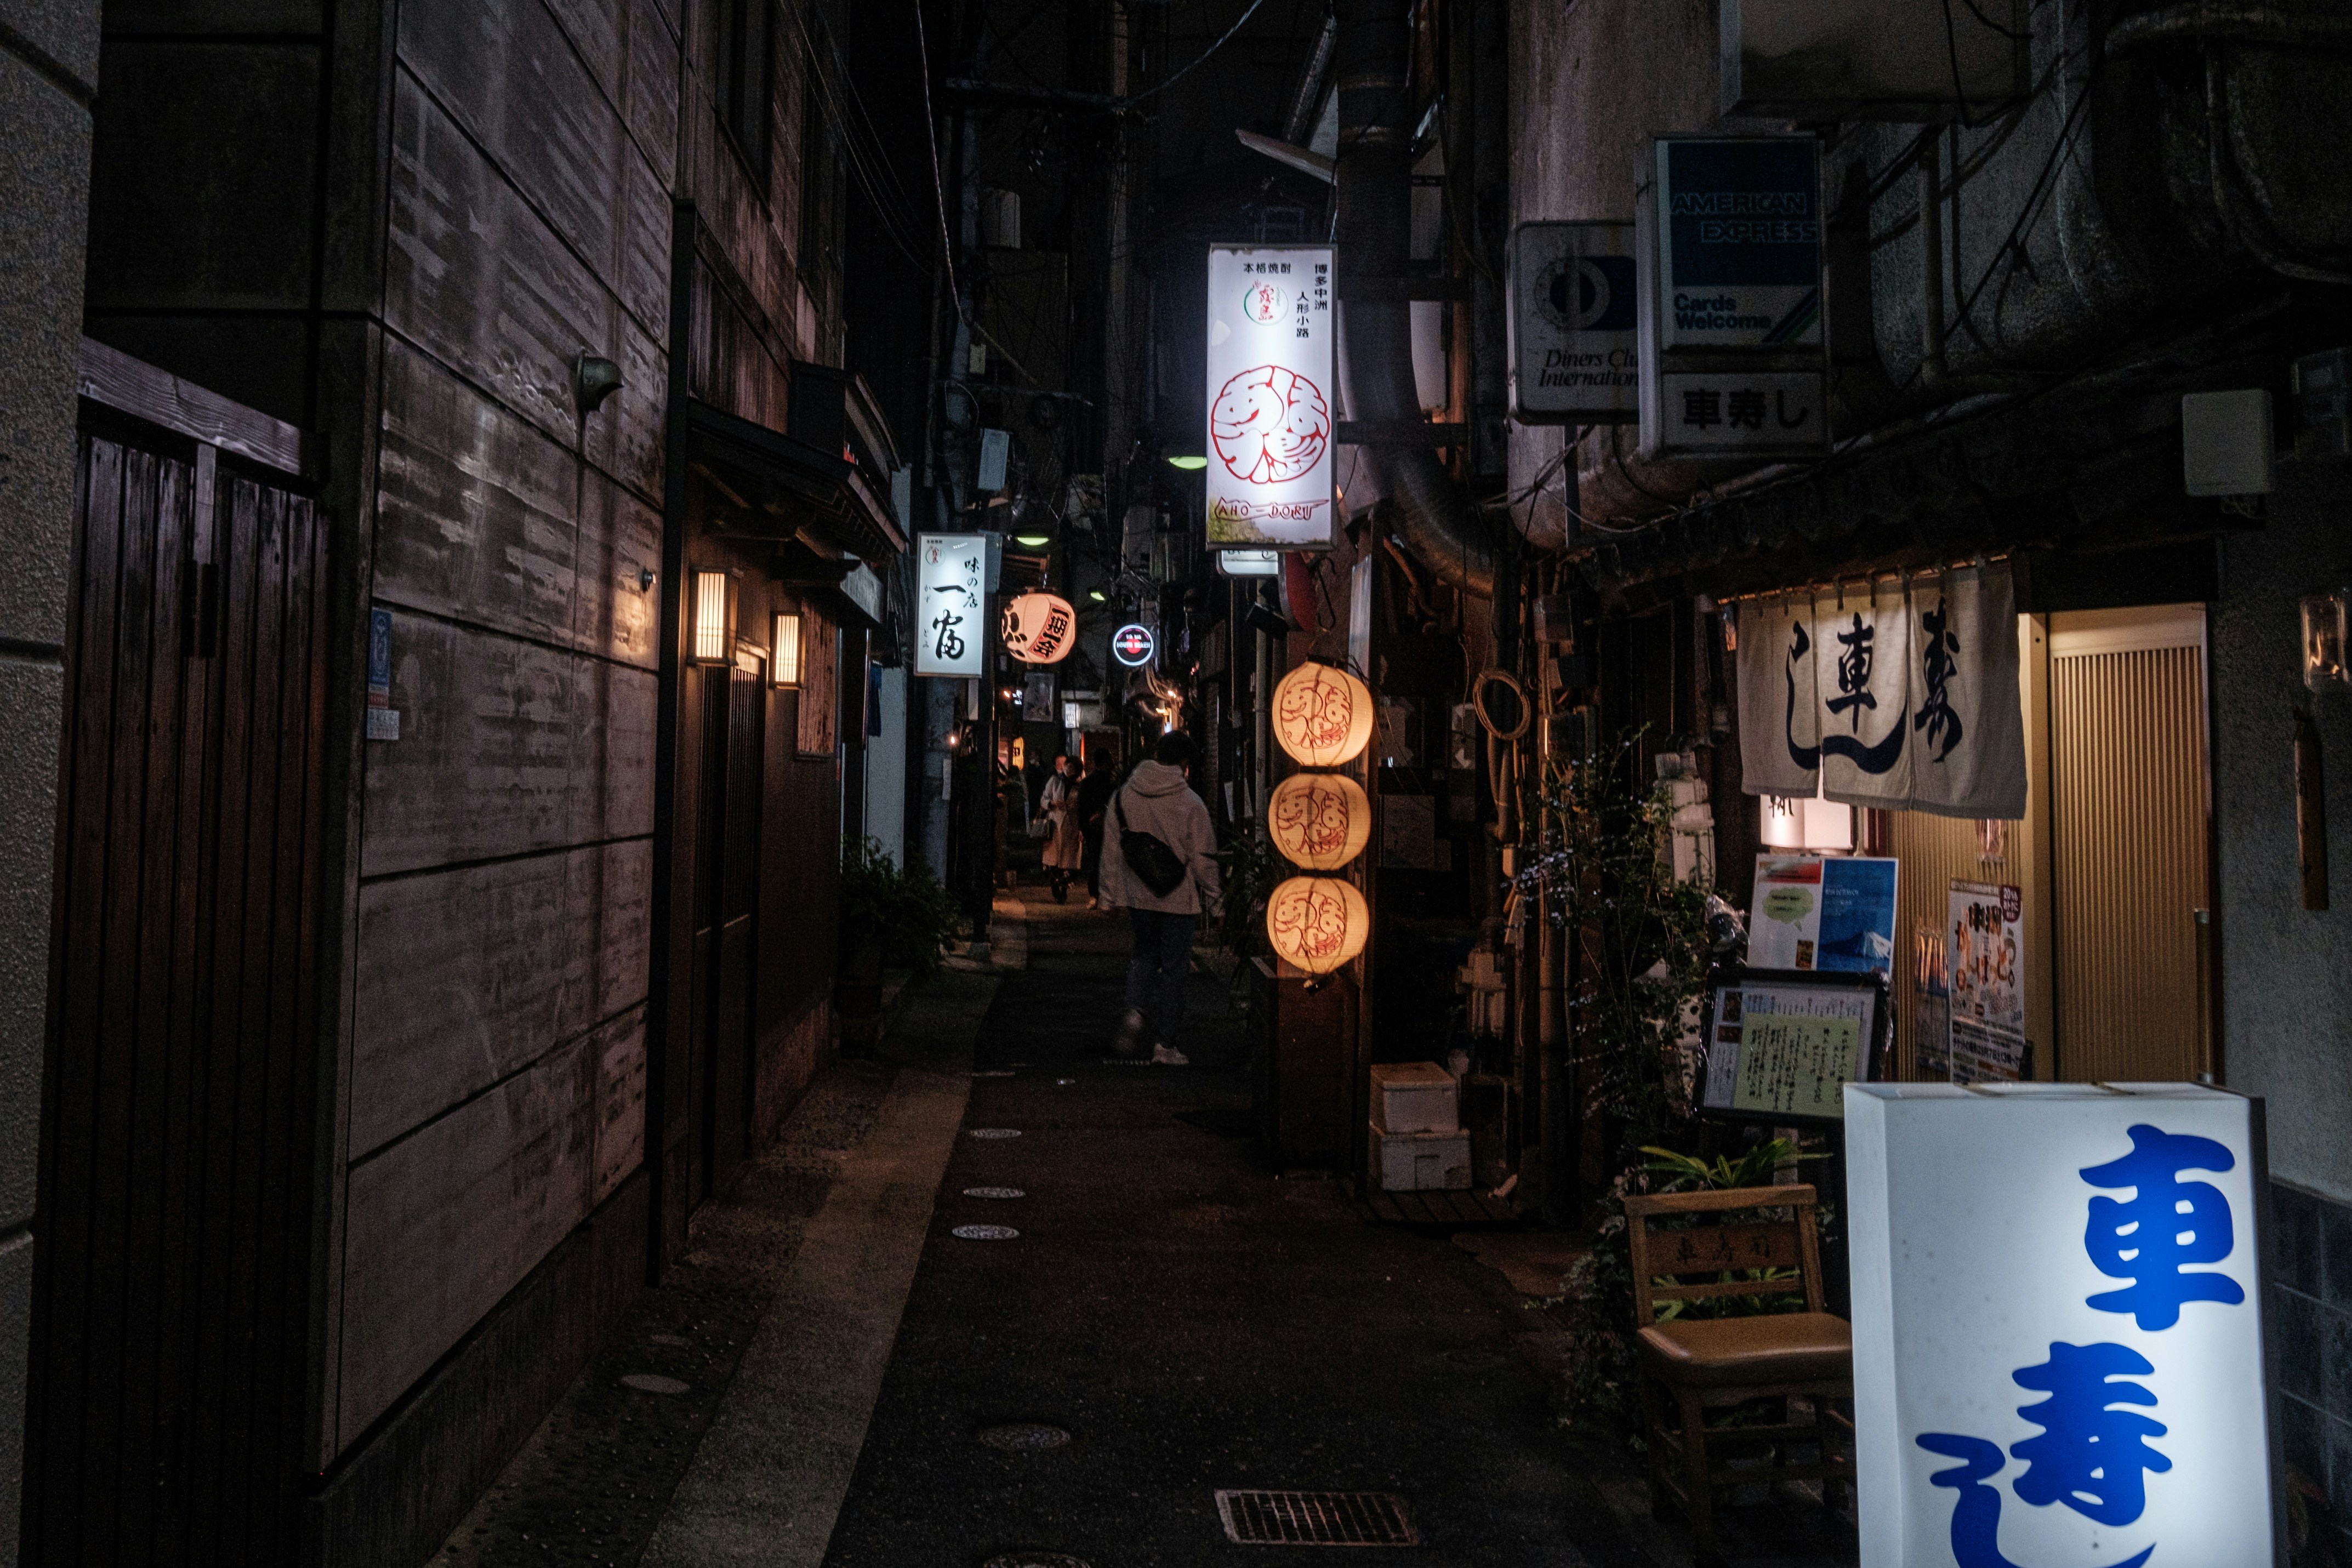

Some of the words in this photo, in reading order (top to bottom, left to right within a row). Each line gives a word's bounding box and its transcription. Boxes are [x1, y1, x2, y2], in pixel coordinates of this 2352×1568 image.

[1671, 192, 1808, 215] AMERICAN
[1700, 220, 1816, 243] EXPRESS
[1243, 263, 1291, 274] 本格焼酎
[1314, 263, 1328, 311] 博多中洲
[1673, 293, 1736, 311] Cards
[1296, 290, 1309, 338] 人形小路
[1675, 312, 1772, 330] Welcome
[1546, 349, 1604, 368] Diners
[1608, 347, 1638, 369] Clu
[1539, 369, 1638, 386] Internation
[1683, 389, 1807, 429] 車寿し
[963, 556, 979, 608] 味の店
[932, 584, 966, 660] 一富
[1033, 607, 1070, 658] 一期一会
